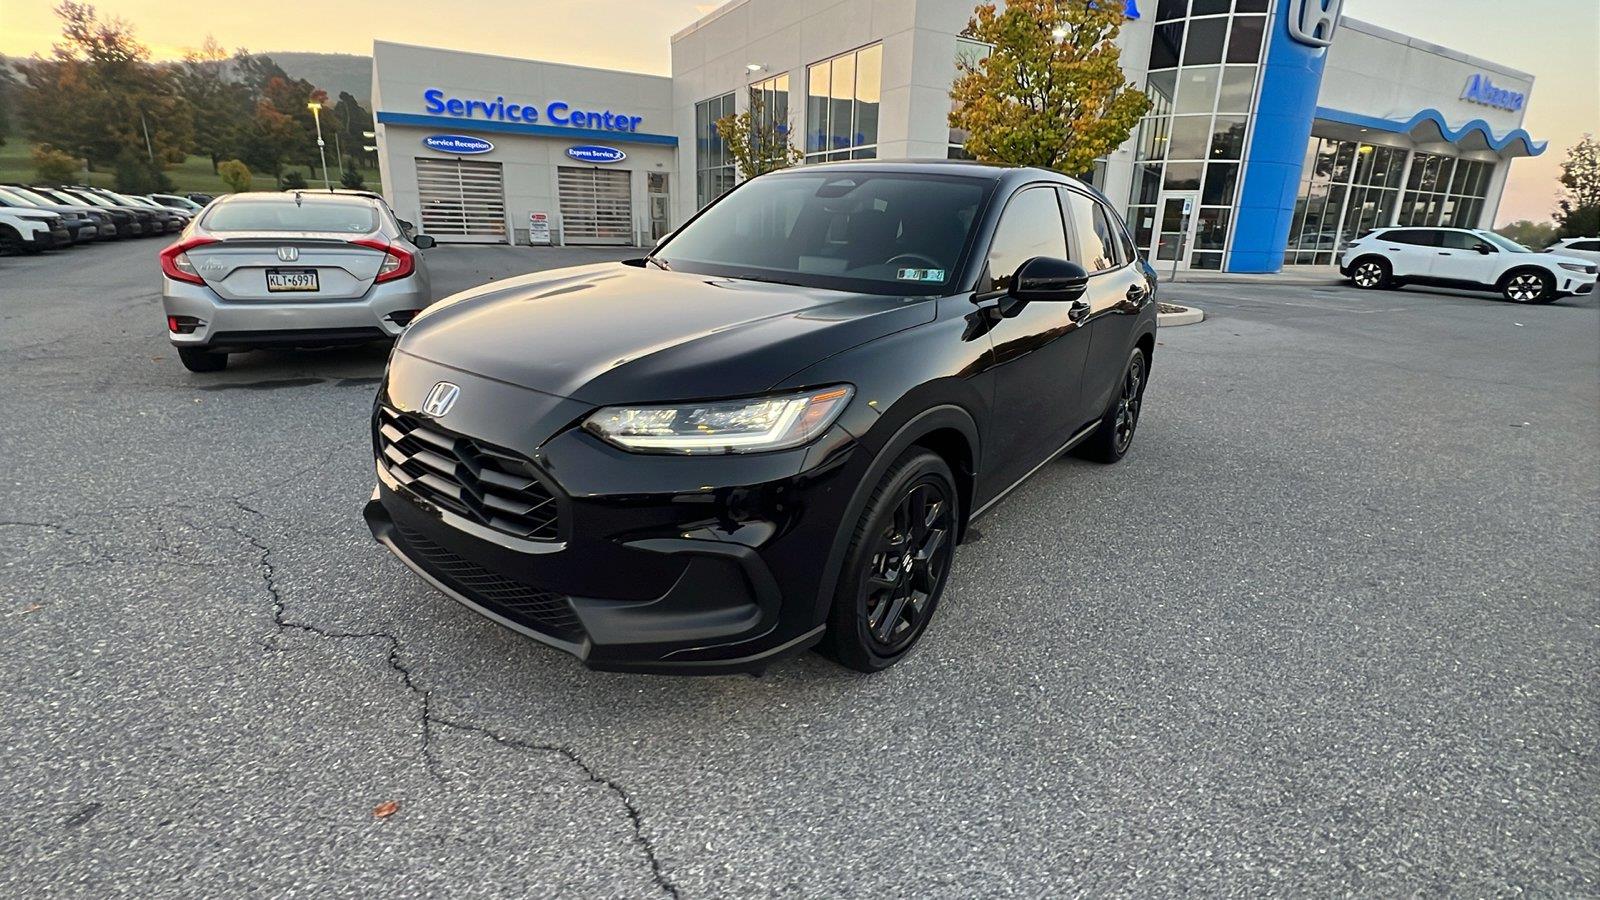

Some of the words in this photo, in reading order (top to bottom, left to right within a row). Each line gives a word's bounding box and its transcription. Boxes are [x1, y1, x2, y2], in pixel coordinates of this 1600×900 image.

[424, 89, 538, 123] Service
[547, 102, 642, 132] Center
[427, 138, 454, 147] Service
[454, 140, 489, 149] Reception
[568, 148, 592, 157] Express
[592, 150, 614, 158] Service
